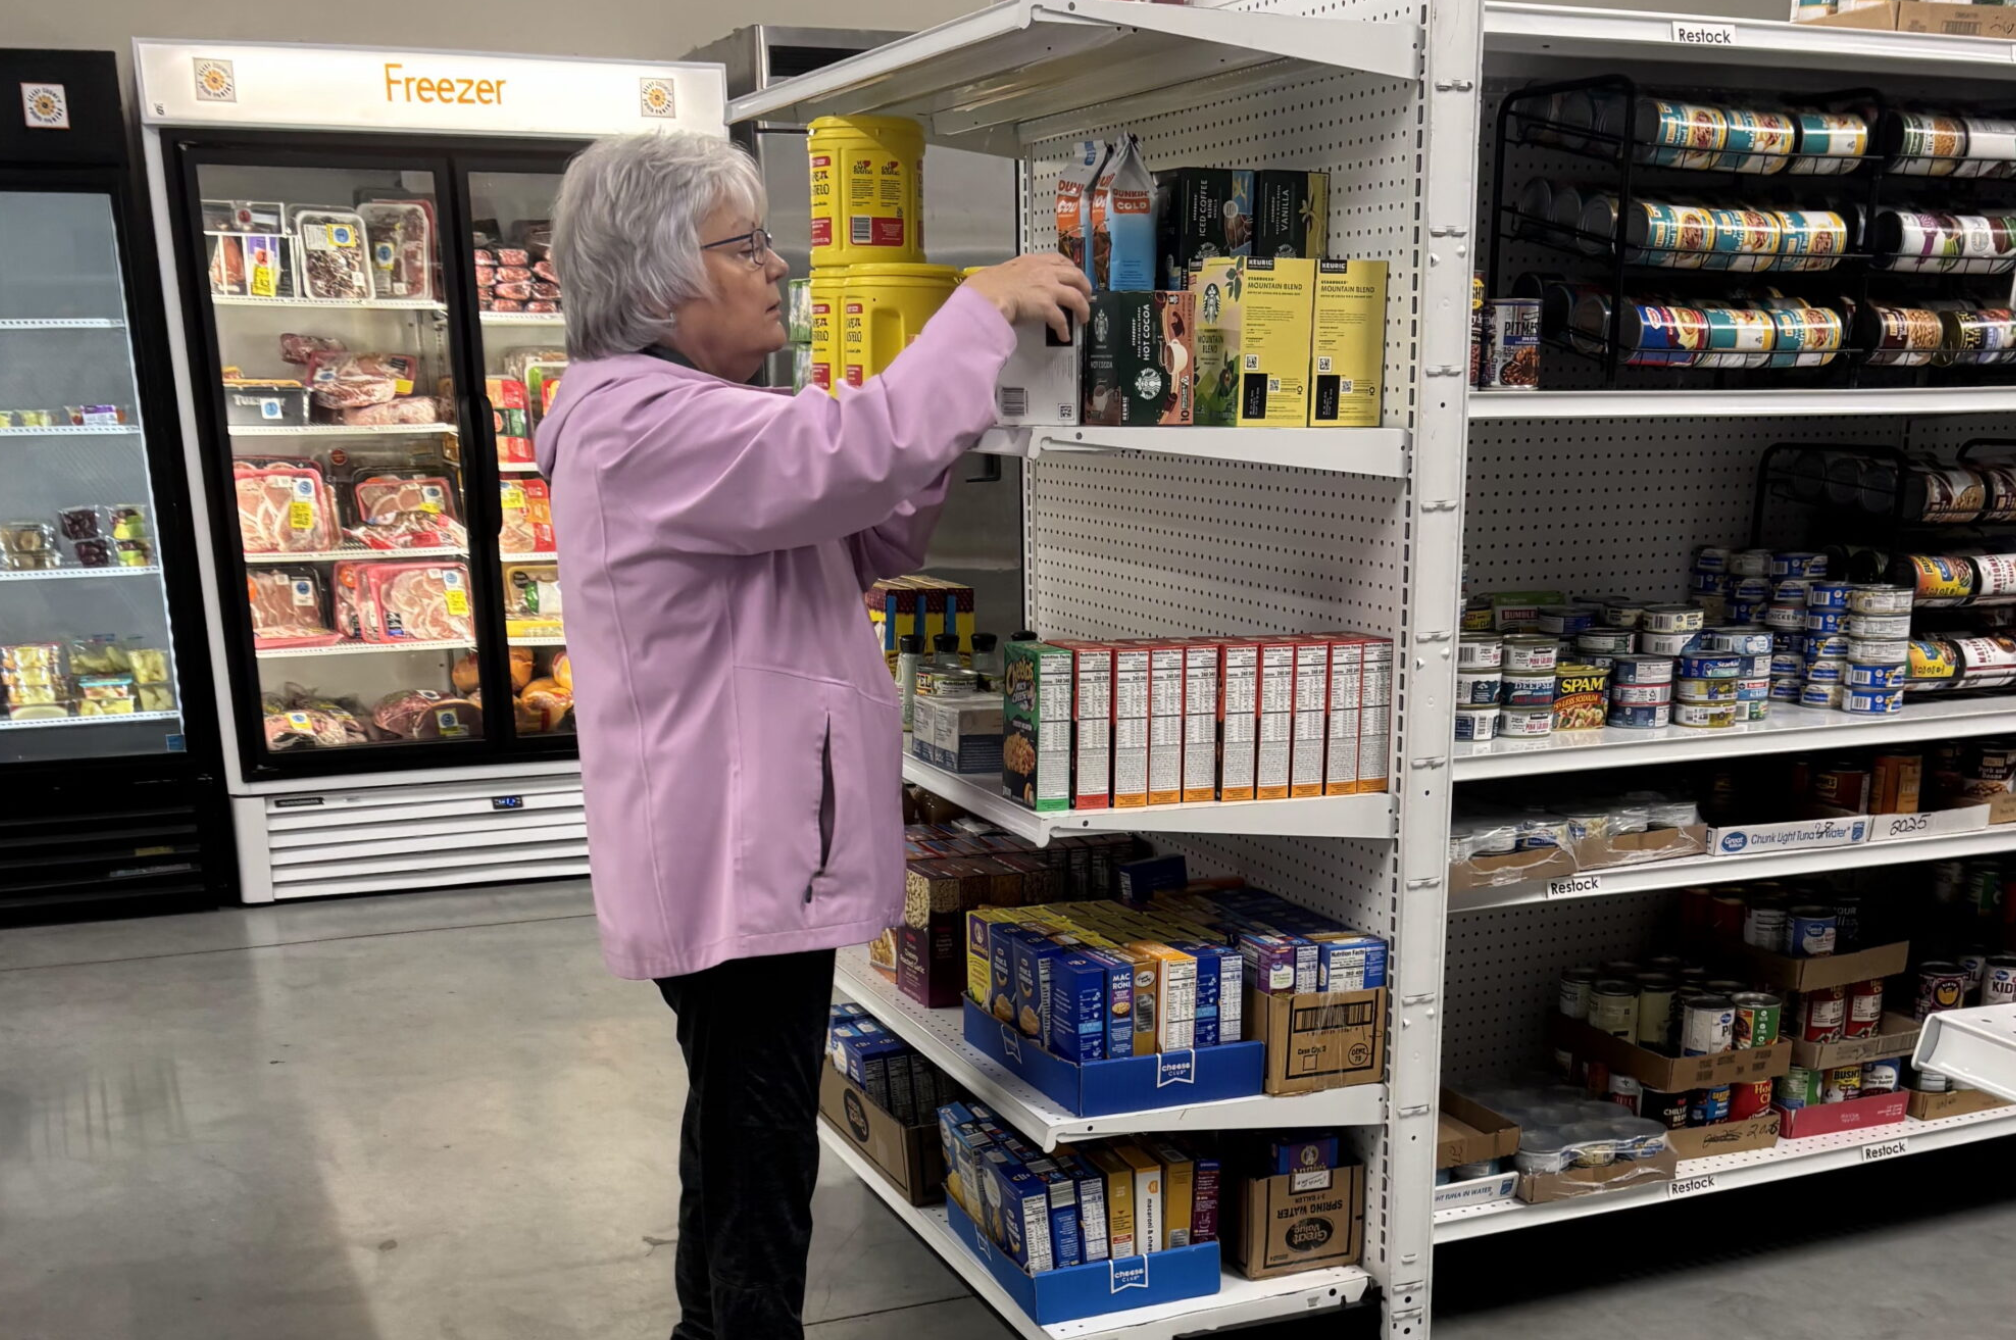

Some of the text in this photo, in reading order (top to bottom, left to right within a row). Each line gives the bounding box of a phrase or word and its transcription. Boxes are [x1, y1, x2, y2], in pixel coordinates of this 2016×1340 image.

[1678, 27, 1732, 44] Restock
[384, 62, 507, 105] Freezer
[1117, 202, 1147, 210] COLD
[1200, 179, 1208, 237] ICED COFFEE
[1281, 189, 1290, 231] VANILLA
[1248, 258, 1273, 266] KEURIG
[1248, 281, 1282, 290] MOUNTAIN
[1321, 285, 1354, 293] MOUNTAIN
[1198, 335, 1223, 344] MOUNTAIN
[1181, 409, 1189, 421] 10
[1561, 677, 1606, 693] SPAM
[1889, 813, 1932, 836] 2025
[1724, 837, 1744, 847] Great
[1751, 833, 1777, 845] Chunk
[1777, 830, 1796, 845] Light
[1796, 829, 1814, 841] Tuna
[1550, 877, 1599, 896] Restock
[1112, 973, 1131, 981] MAC
[1112, 981, 1131, 990] RONI
[1161, 1062, 1191, 1072] cheese
[1865, 1141, 1906, 1160] Restock
[1671, 1174, 1715, 1195] Restock
[1444, 1186, 1493, 1201] TUNA IN WATER
[1277, 1199, 1343, 1220] SPRING WATER
[1293, 1222, 1320, 1234] Value
[1292, 1230, 1328, 1246] Great
[1114, 1267, 1145, 1279] cheese
